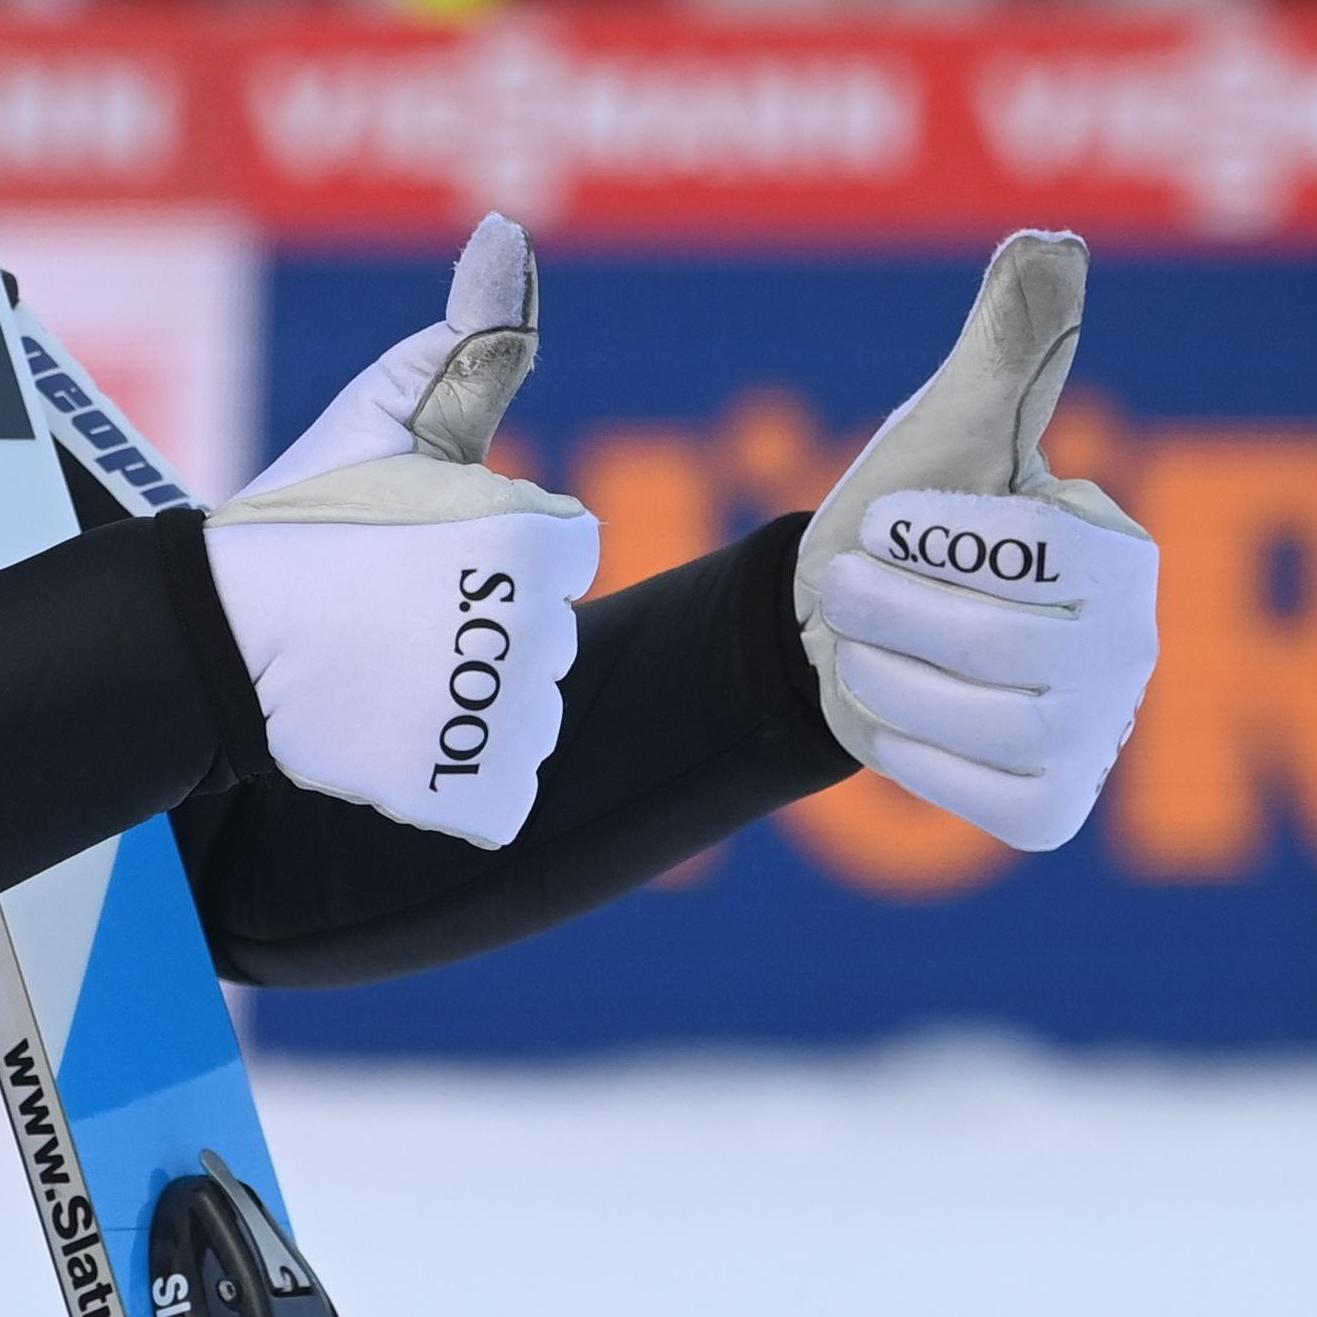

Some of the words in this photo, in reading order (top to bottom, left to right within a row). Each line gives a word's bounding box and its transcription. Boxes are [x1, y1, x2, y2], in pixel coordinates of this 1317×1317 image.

[21, 335, 192, 511] neopl
[888, 519, 1060, 583] S.COOL
[429, 568, 515, 793] S.COOL
